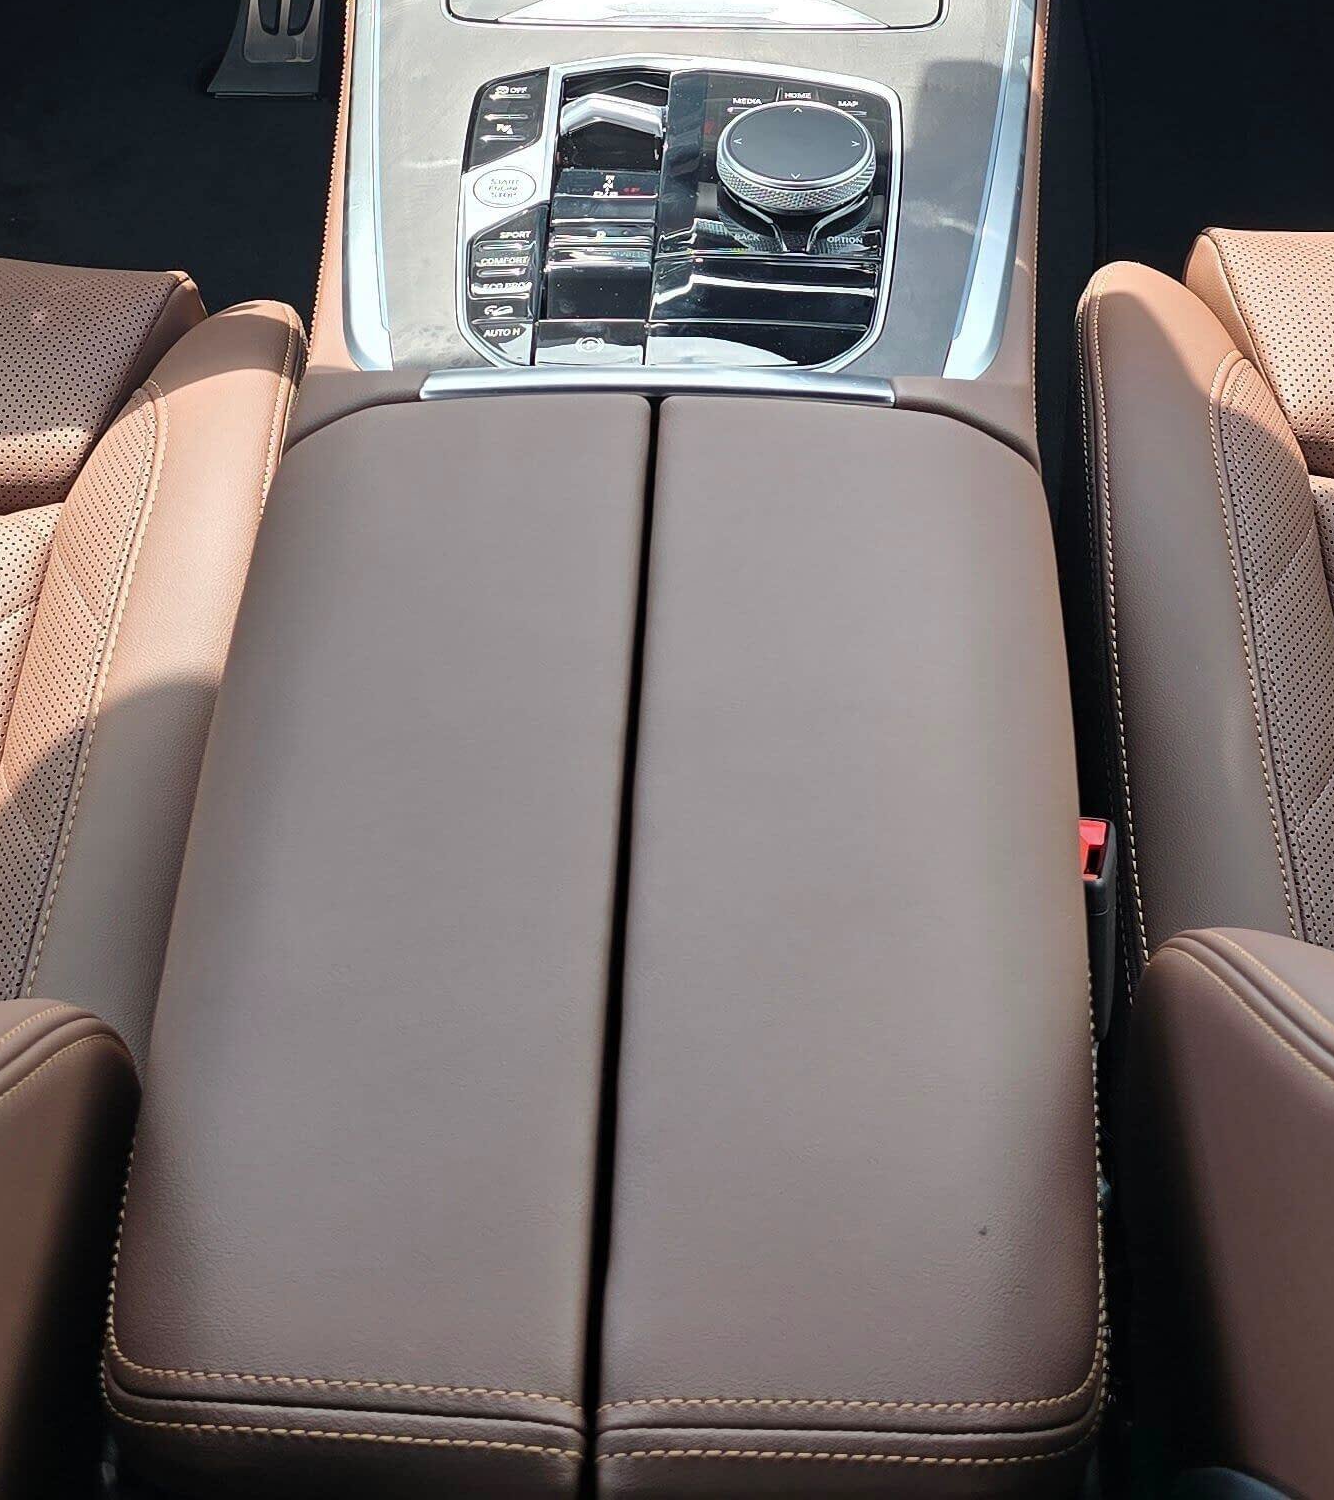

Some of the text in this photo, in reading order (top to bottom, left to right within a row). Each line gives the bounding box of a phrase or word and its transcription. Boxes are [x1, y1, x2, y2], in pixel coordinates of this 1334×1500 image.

[732, 97, 762, 105] MEDIA
[499, 230, 532, 239] SPORT
[734, 233, 760, 242] BACK
[827, 235, 863, 244] OPTION
[481, 256, 530, 265] COMFORT
[483, 328, 511, 337] AUTO
